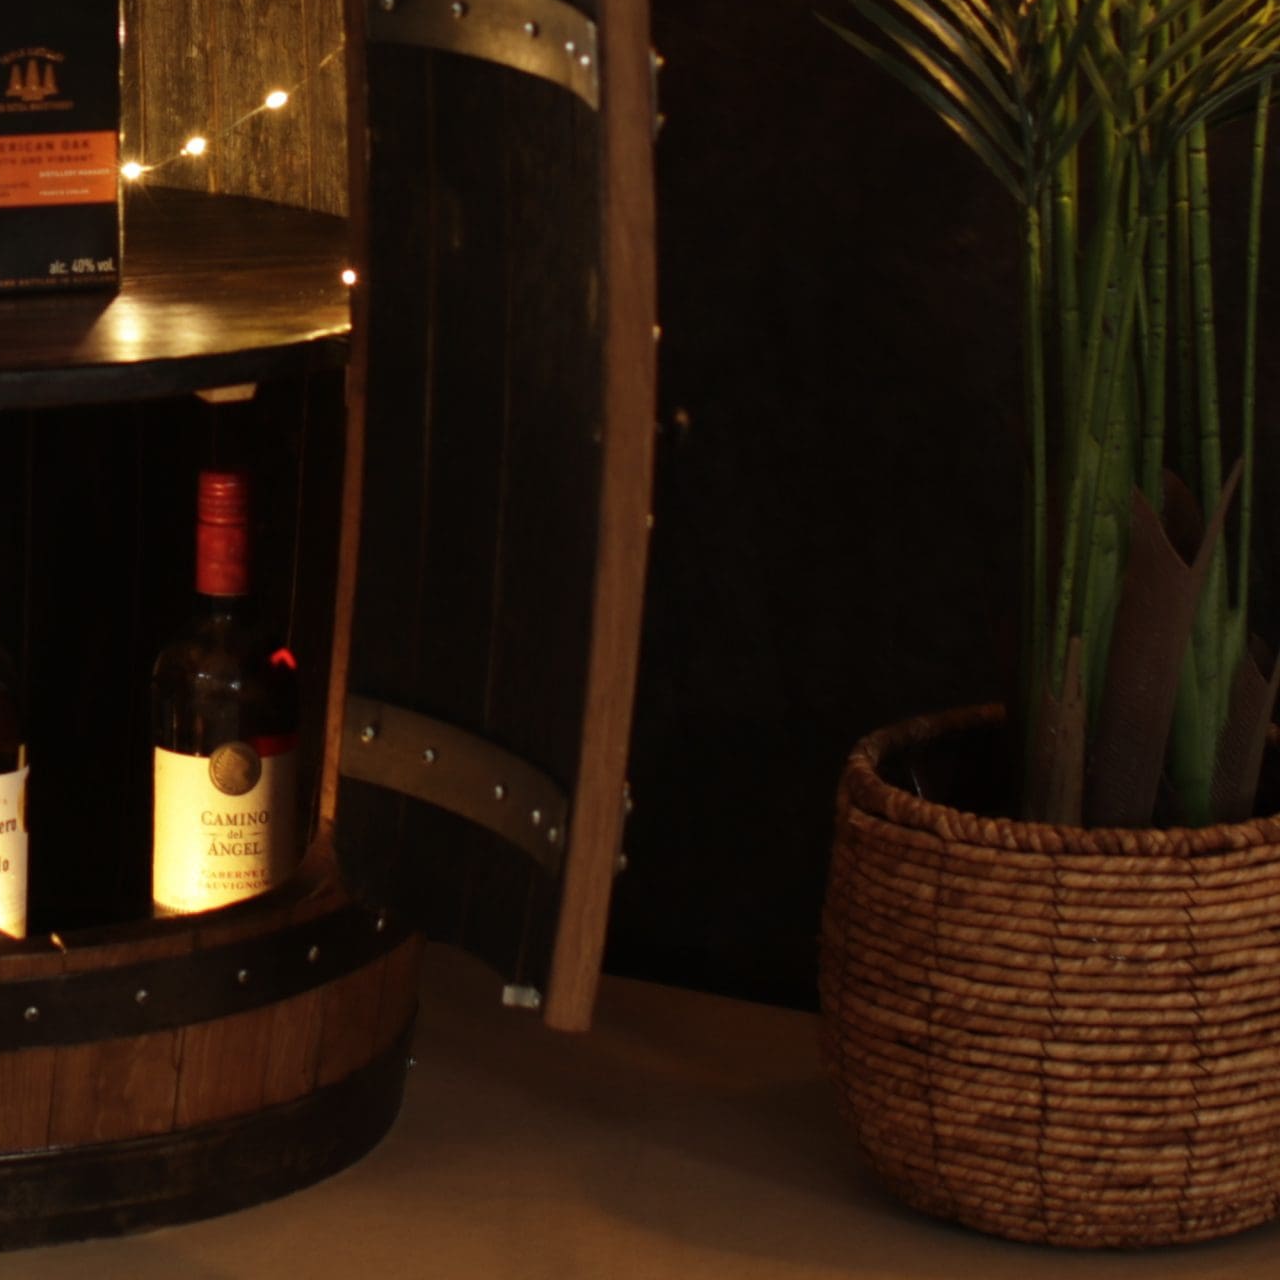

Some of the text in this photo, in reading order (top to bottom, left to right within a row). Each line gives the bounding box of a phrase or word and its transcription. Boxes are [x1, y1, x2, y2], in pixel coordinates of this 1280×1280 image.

[61, 139, 90, 150] OAK
[71, 258, 95, 273] 40%
[201, 810, 269, 826] CAMINO
[227, 829, 243, 840] del
